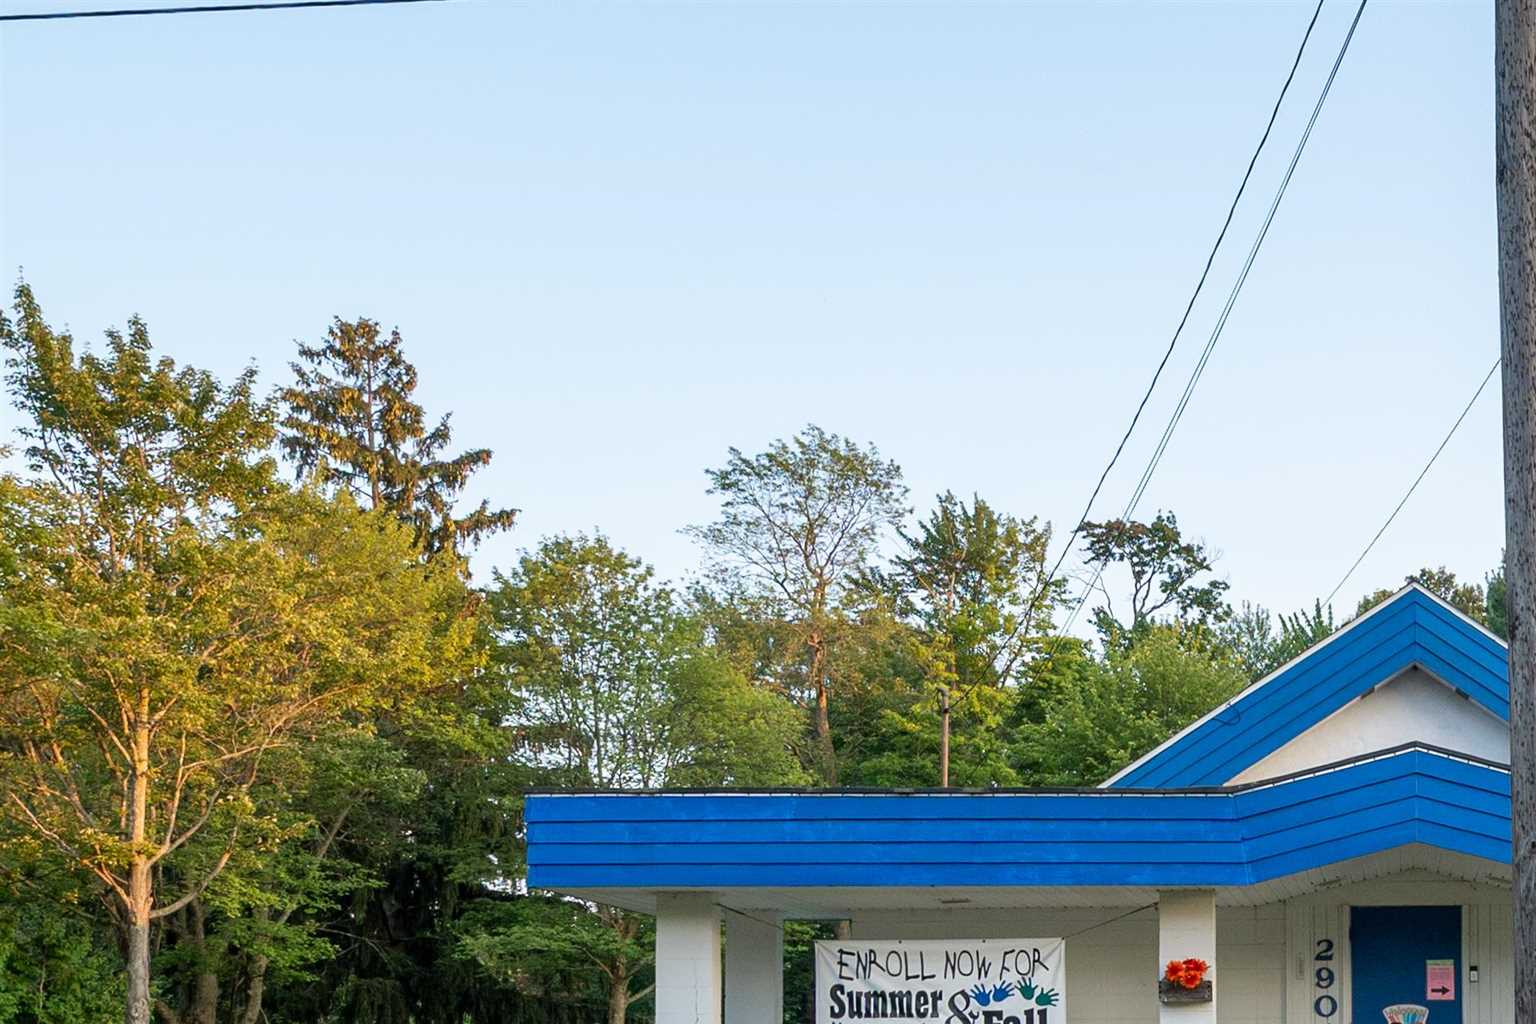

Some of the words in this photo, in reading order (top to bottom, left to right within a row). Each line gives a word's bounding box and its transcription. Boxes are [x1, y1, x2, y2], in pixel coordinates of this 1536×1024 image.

[837, 949, 936, 981] ENROLL
[944, 950, 992, 981] NOW
[999, 948, 1050, 981] FOR
[829, 983, 943, 1019] Summer
